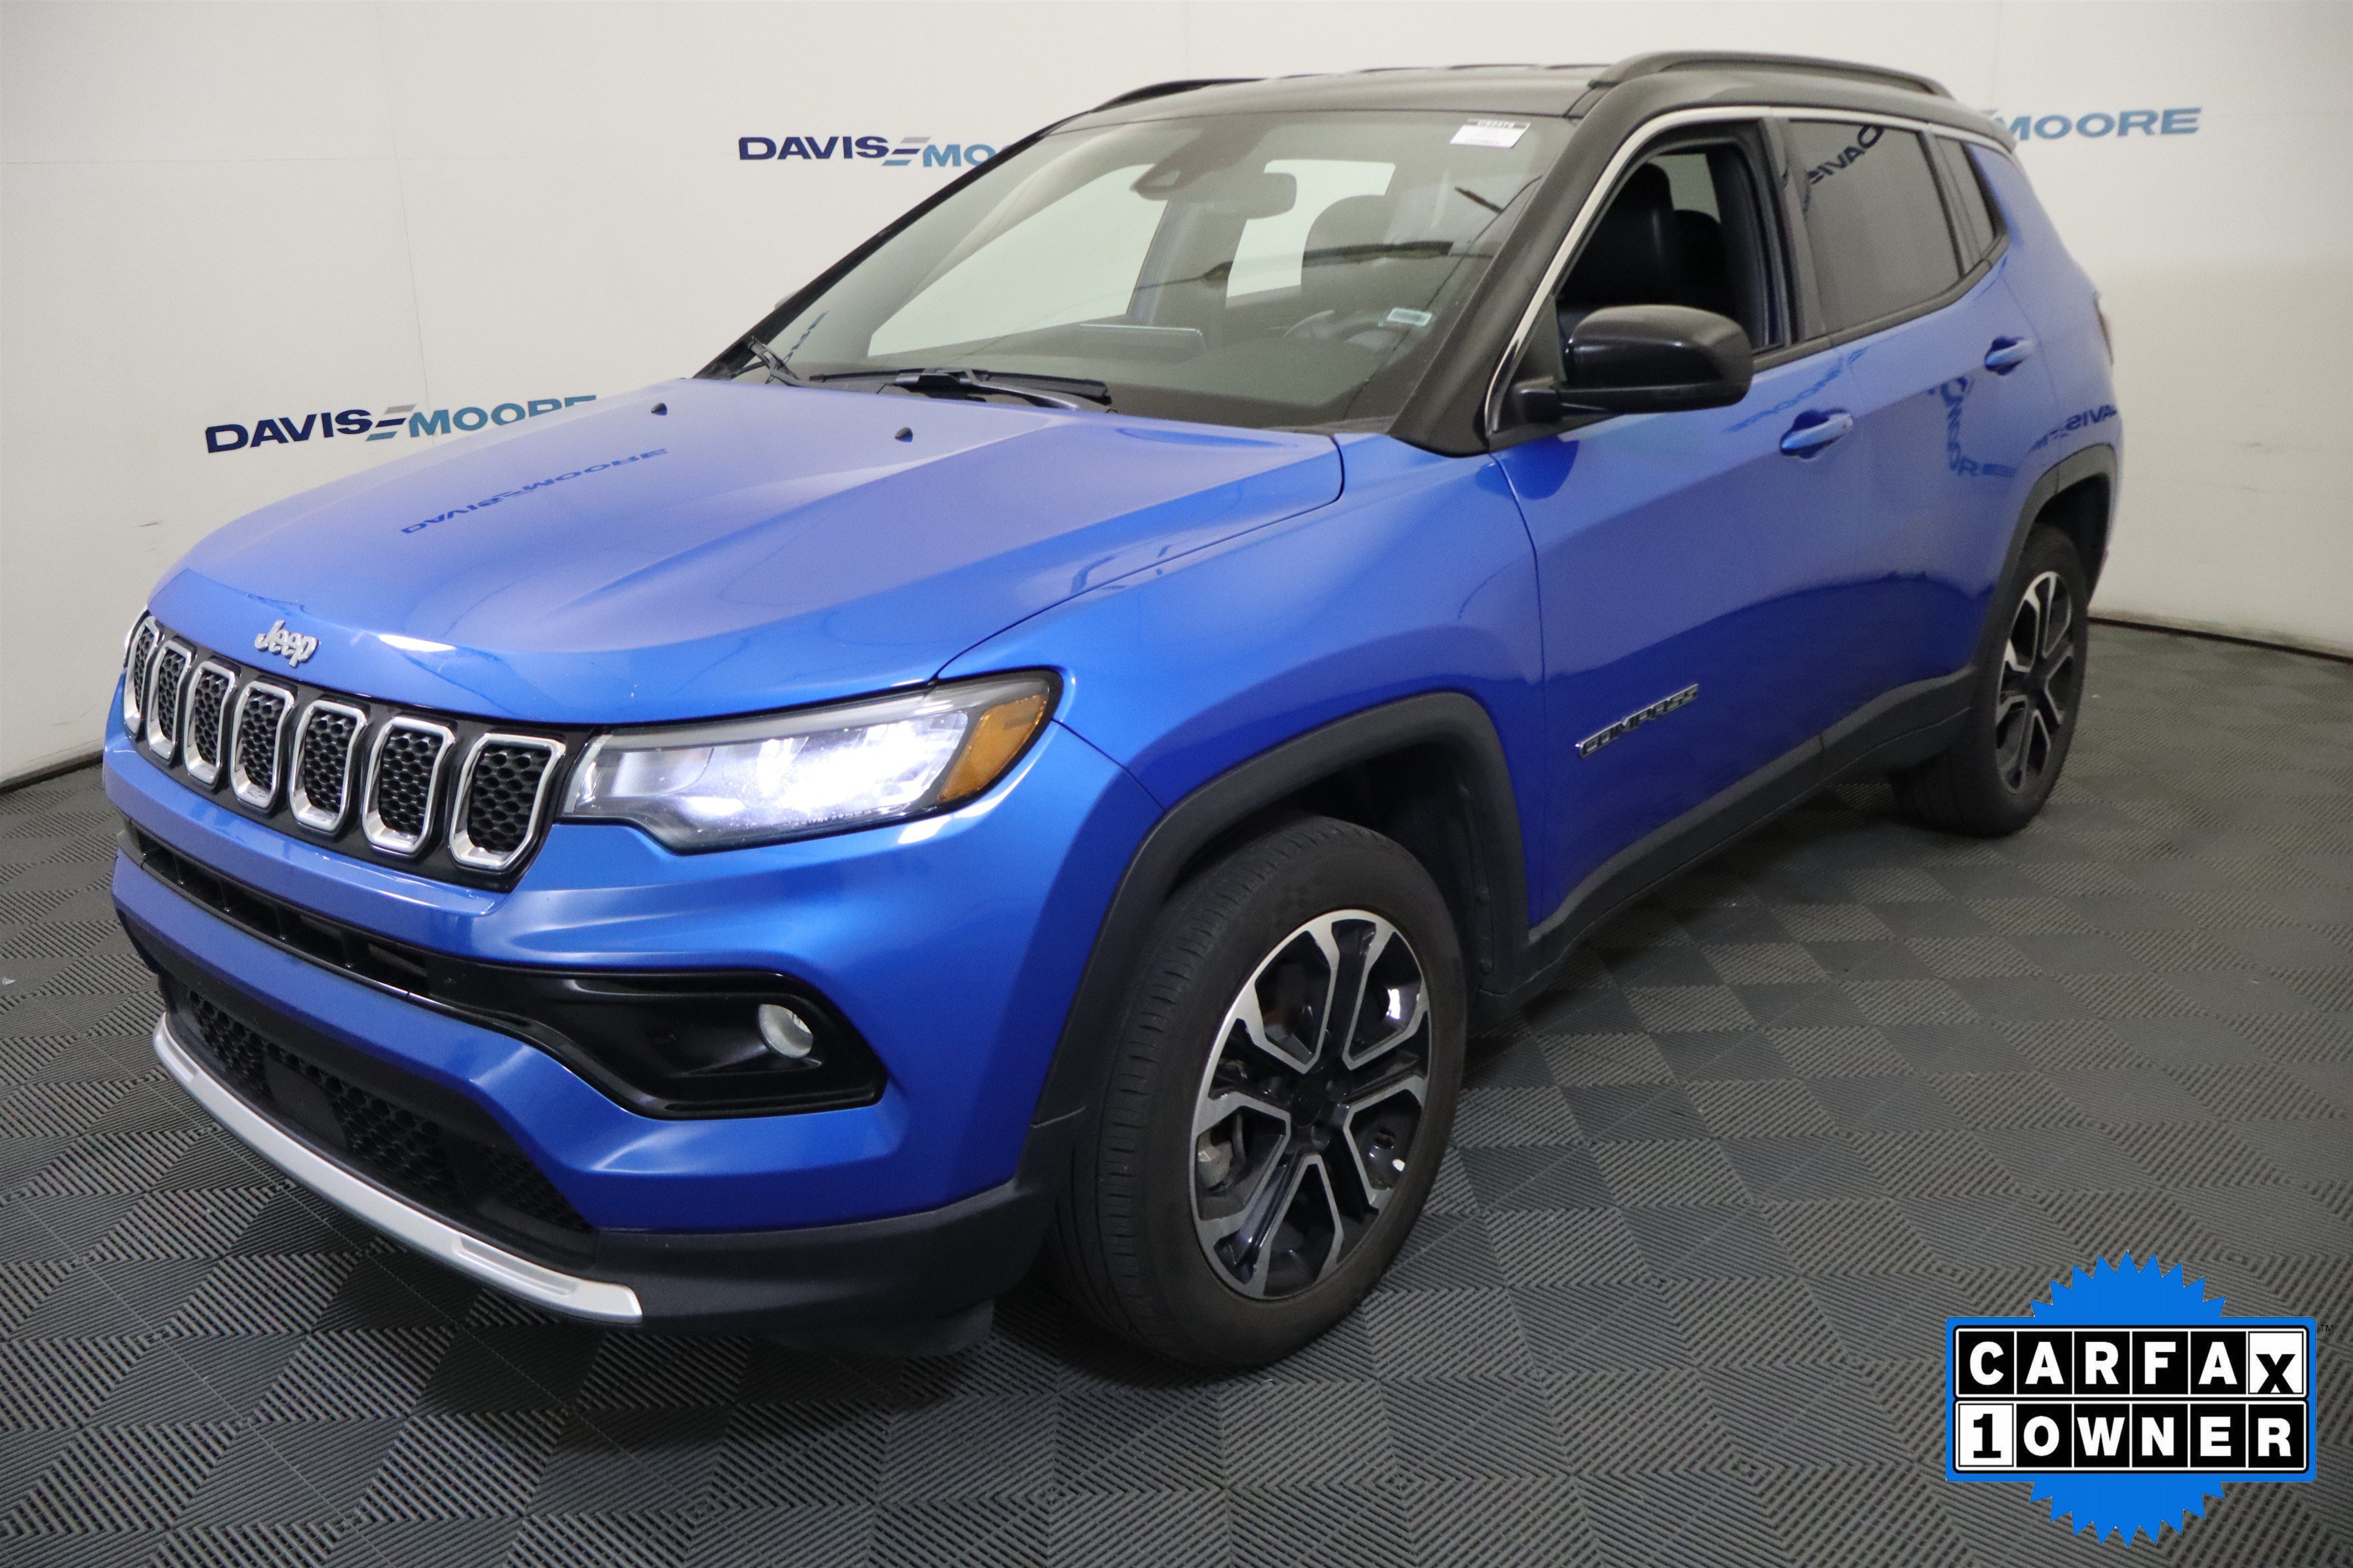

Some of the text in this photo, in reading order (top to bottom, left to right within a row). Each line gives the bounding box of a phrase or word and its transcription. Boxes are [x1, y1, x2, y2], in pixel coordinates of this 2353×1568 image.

[738, 136, 1011, 168] DAVIS MO
[205, 409, 373, 453] DAVIS
[254, 619, 319, 667] Jeep
